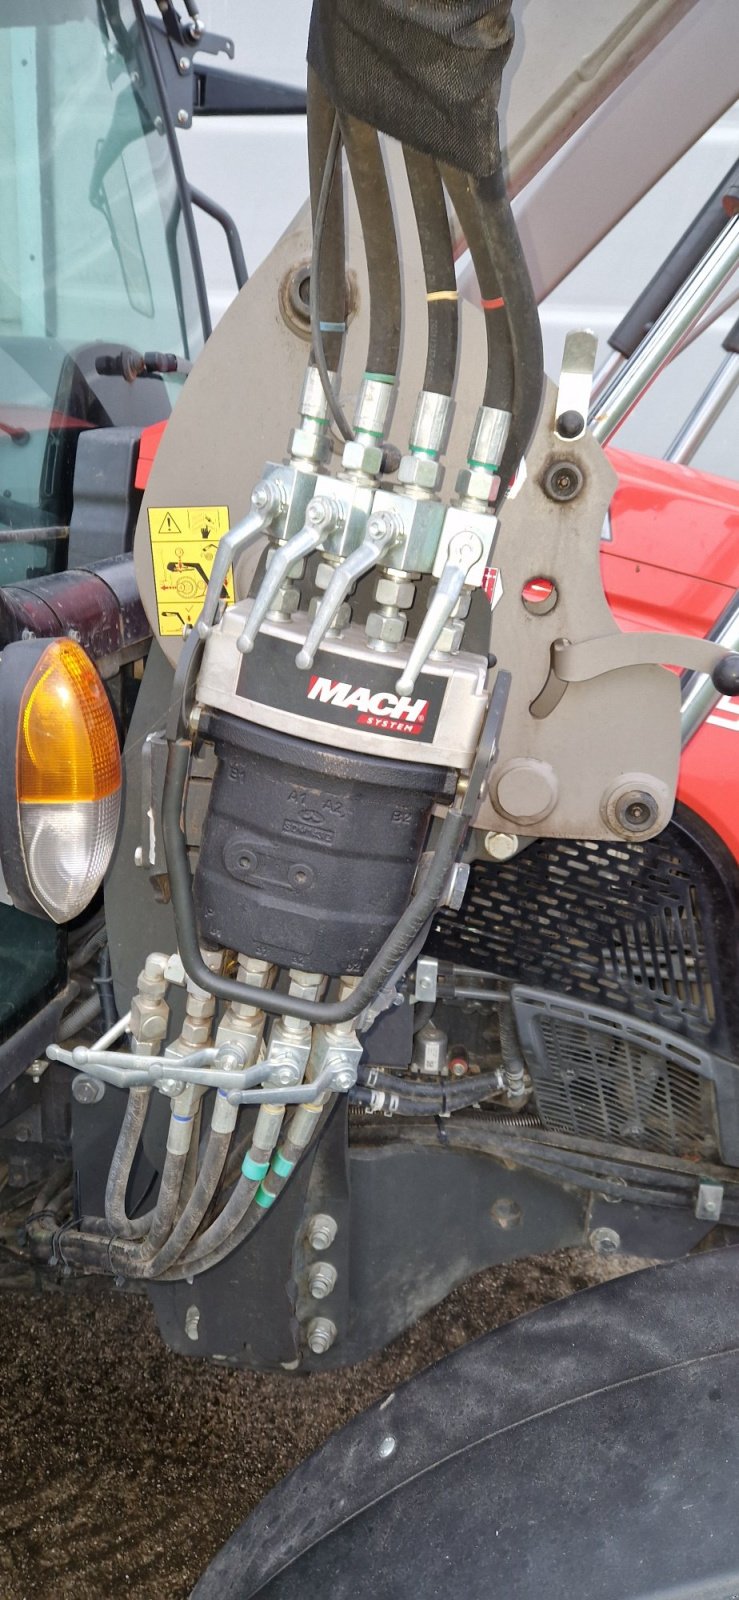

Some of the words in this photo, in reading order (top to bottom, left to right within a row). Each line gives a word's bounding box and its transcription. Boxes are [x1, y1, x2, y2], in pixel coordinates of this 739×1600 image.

[307, 677, 428, 722] MACH
[366, 716, 413, 732] SYSTEM
[287, 790, 307, 807] A1
[322, 799, 345, 817] A2
[391, 810, 411, 824] B2
